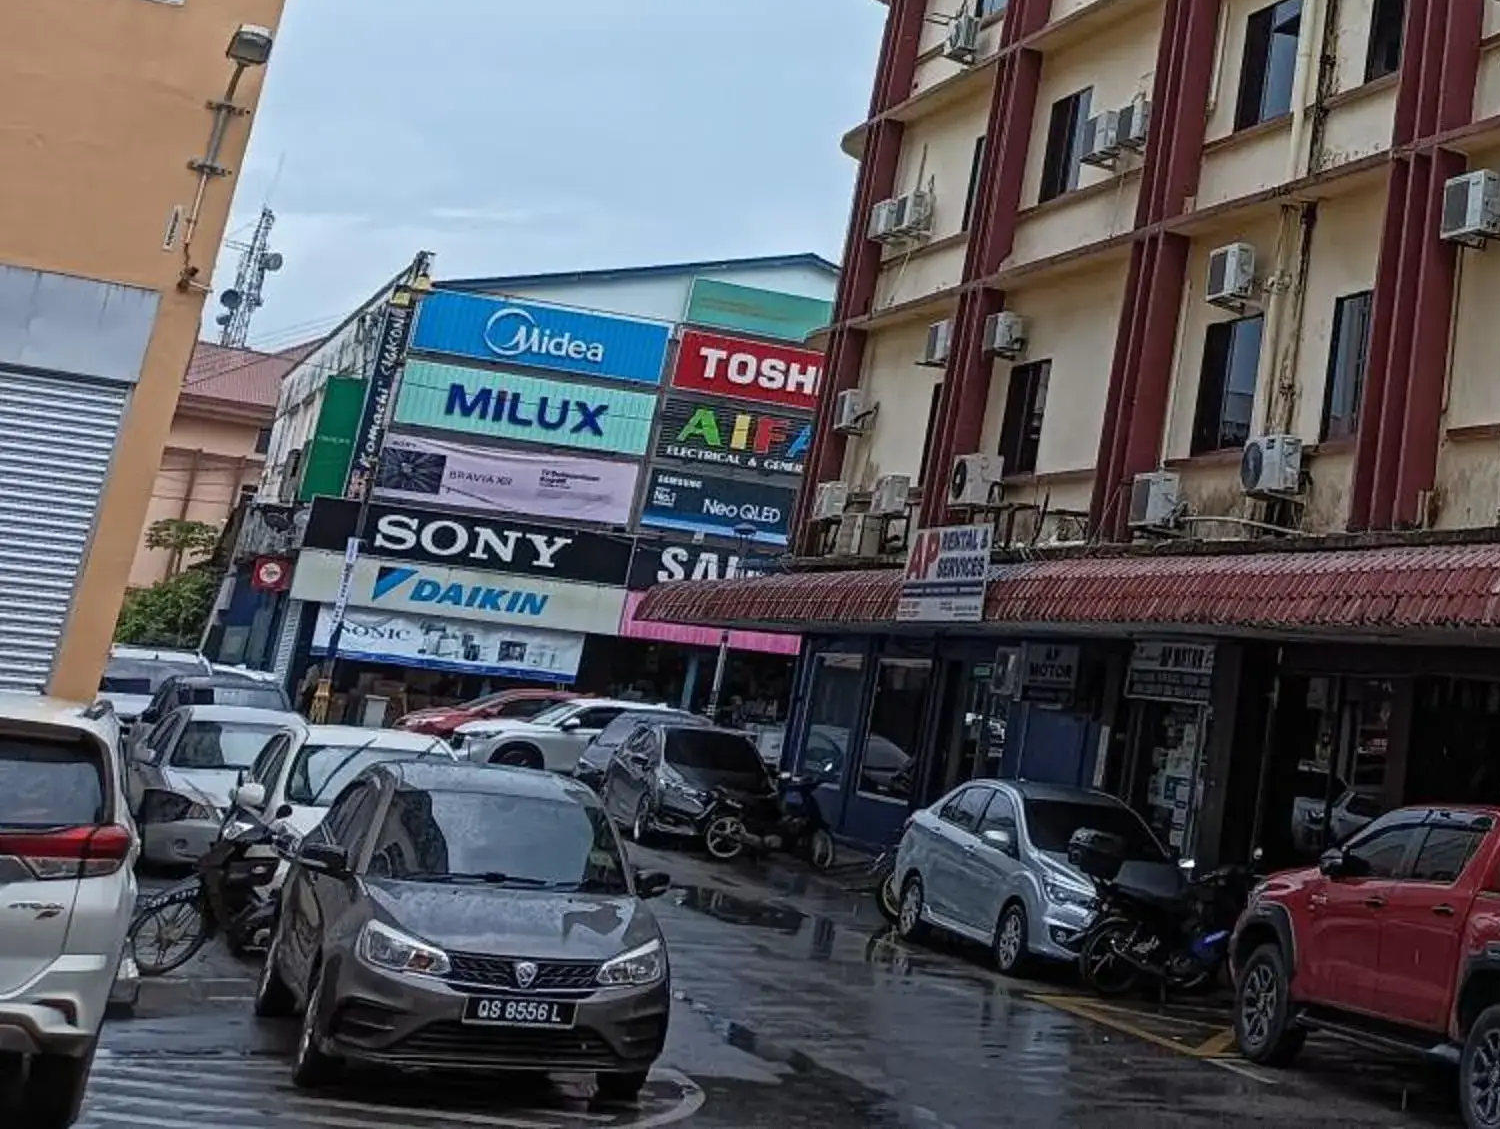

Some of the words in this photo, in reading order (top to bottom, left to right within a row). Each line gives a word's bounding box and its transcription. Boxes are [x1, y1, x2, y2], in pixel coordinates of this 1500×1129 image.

[502, 324, 604, 362] Midea
[444, 382, 609, 436] MILUX
[666, 445, 740, 465] ELECTRICAL
[747, 458, 757, 468] &
[449, 471, 494, 484] BRAVIA
[657, 474, 703, 489] SAMSUNG
[703, 499, 738, 518] Neo
[739, 503, 780, 524] QLED
[374, 515, 572, 568] SONY
[942, 529, 978, 551] RENTAL
[906, 531, 940, 579] AP
[936, 555, 985, 579] SERVICES
[410, 579, 549, 615] DAIKIN
[1029, 662, 1073, 680] MOTOR
[477, 1000, 502, 1019] QS
[505, 1001, 549, 1021] 8556
[551, 1003, 561, 1022] L
